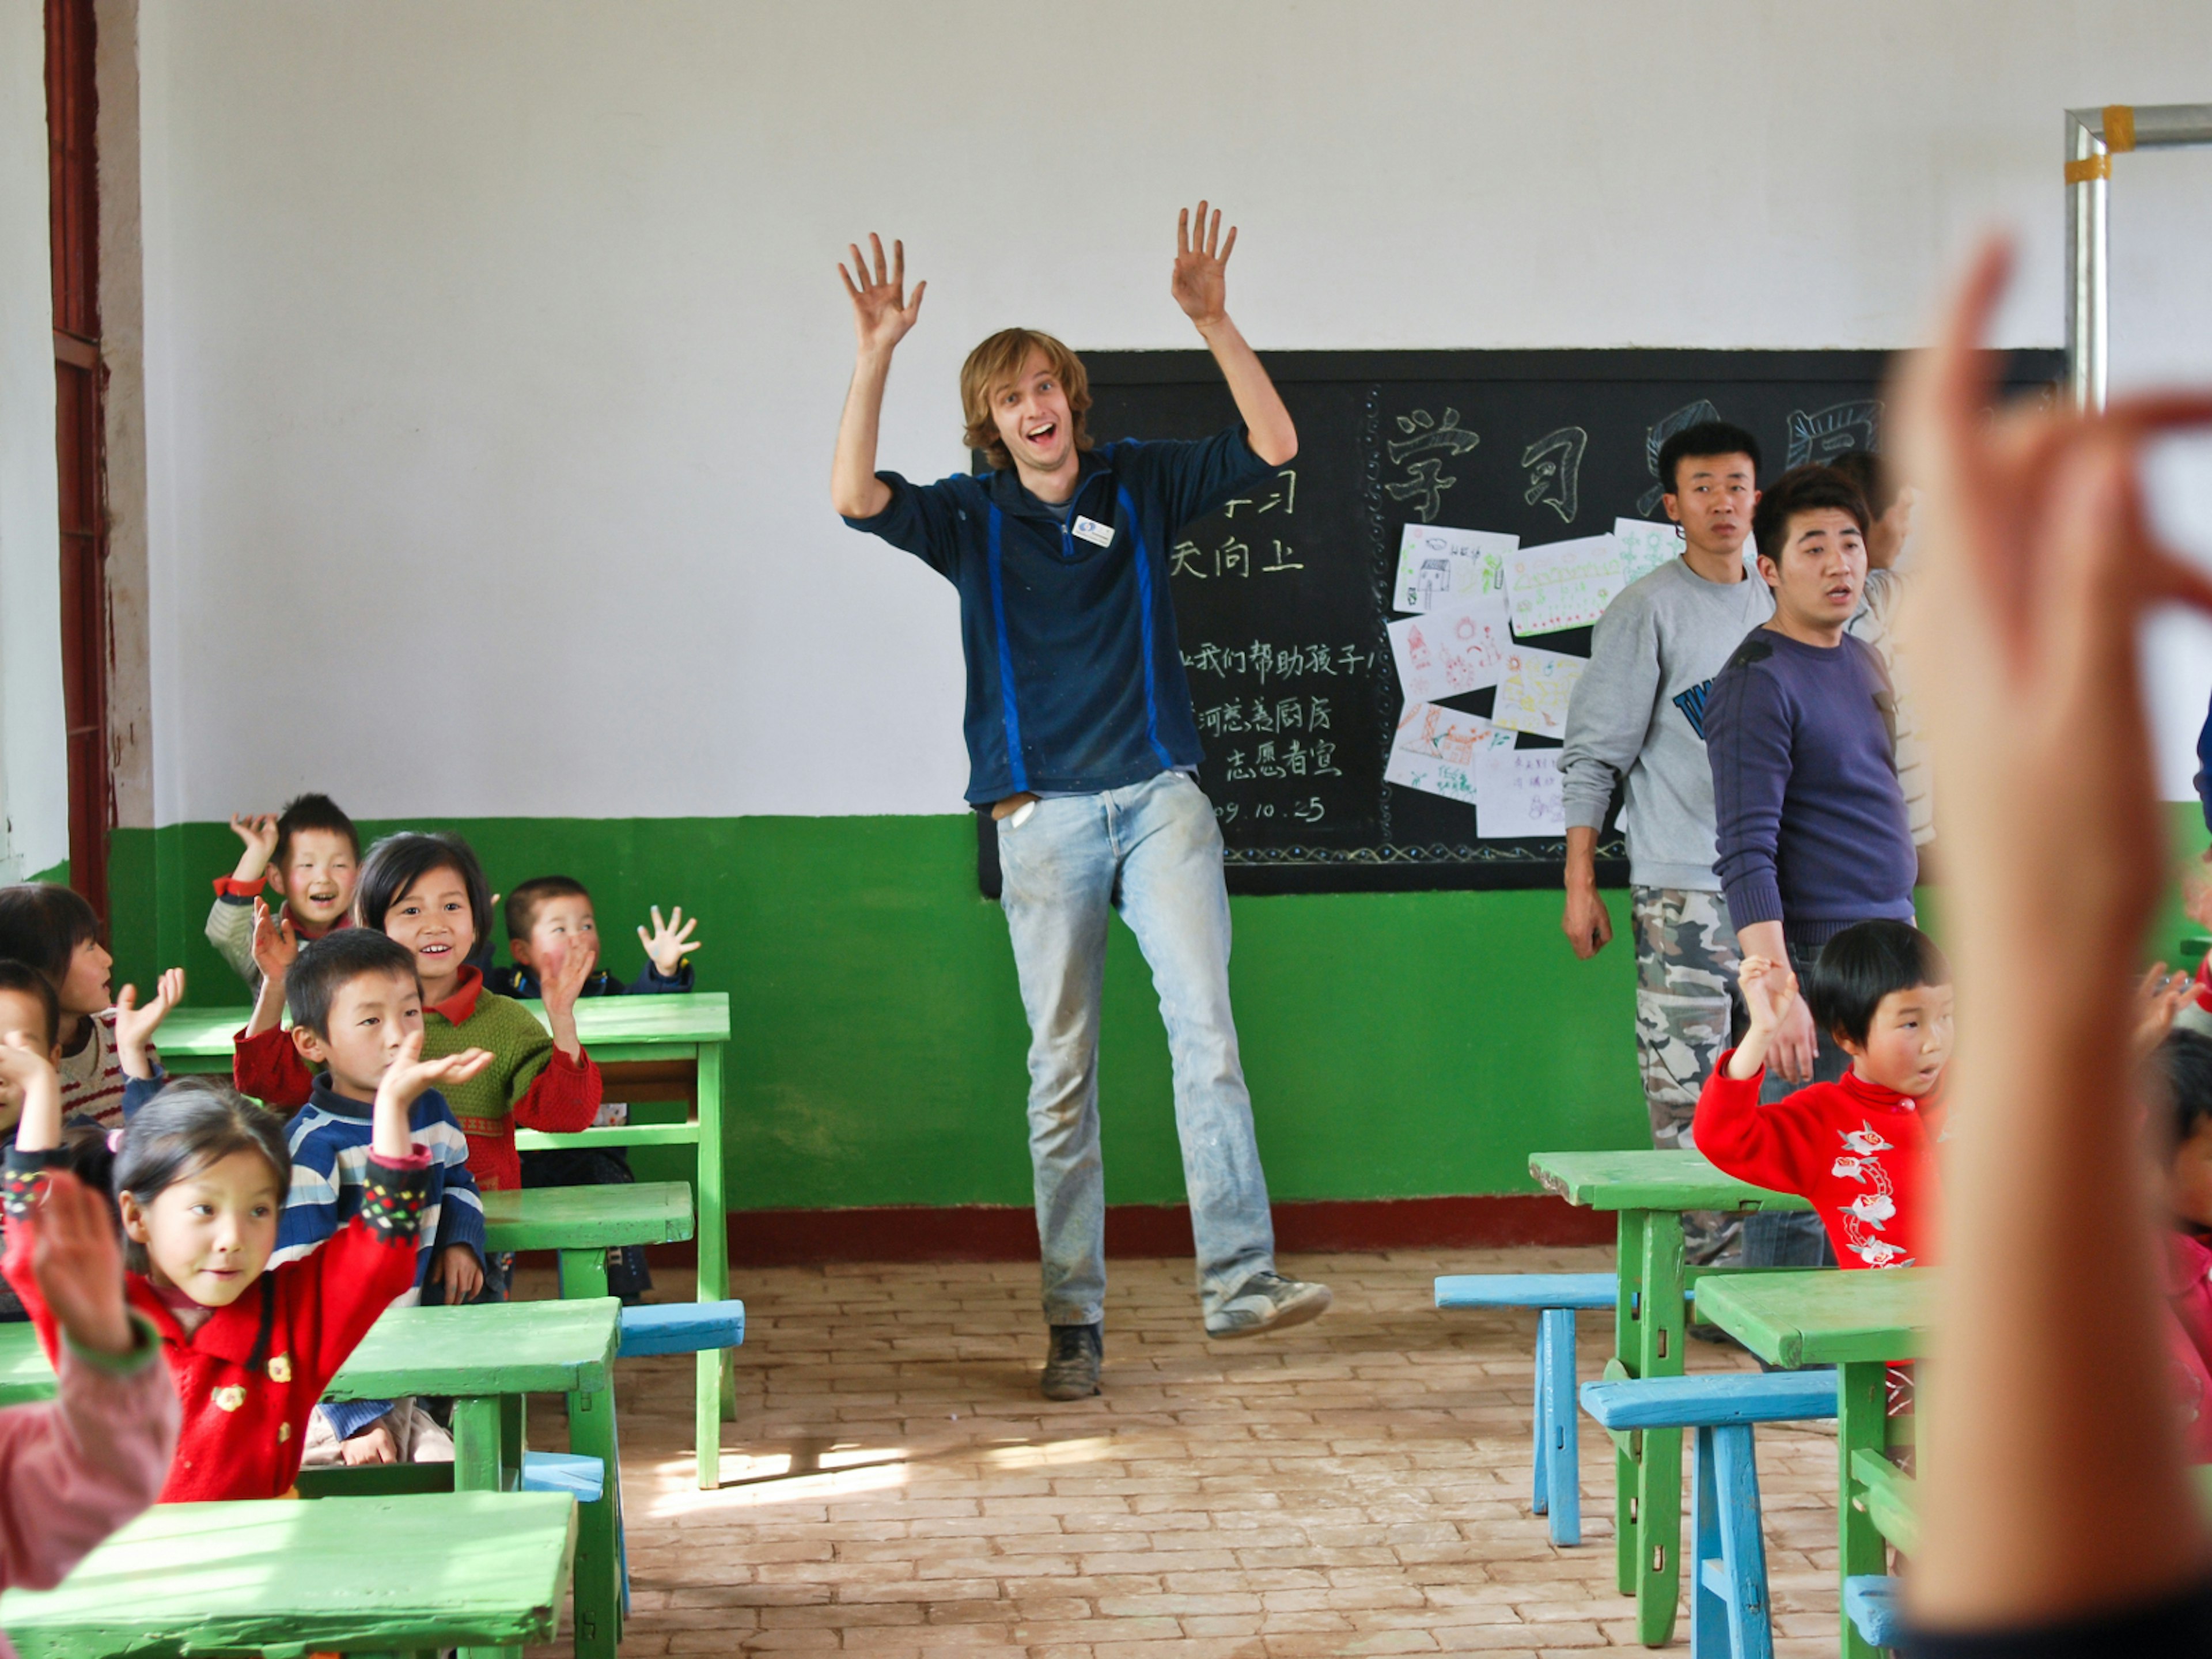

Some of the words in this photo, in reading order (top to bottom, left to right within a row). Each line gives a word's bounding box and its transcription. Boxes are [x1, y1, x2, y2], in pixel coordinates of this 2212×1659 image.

[1225, 469, 1297, 518] 习
[1170, 536, 1304, 579] 天向上
[1190, 696, 1332, 737] 河慈善厨房
[1226, 739, 1342, 782] 志愿者宣
